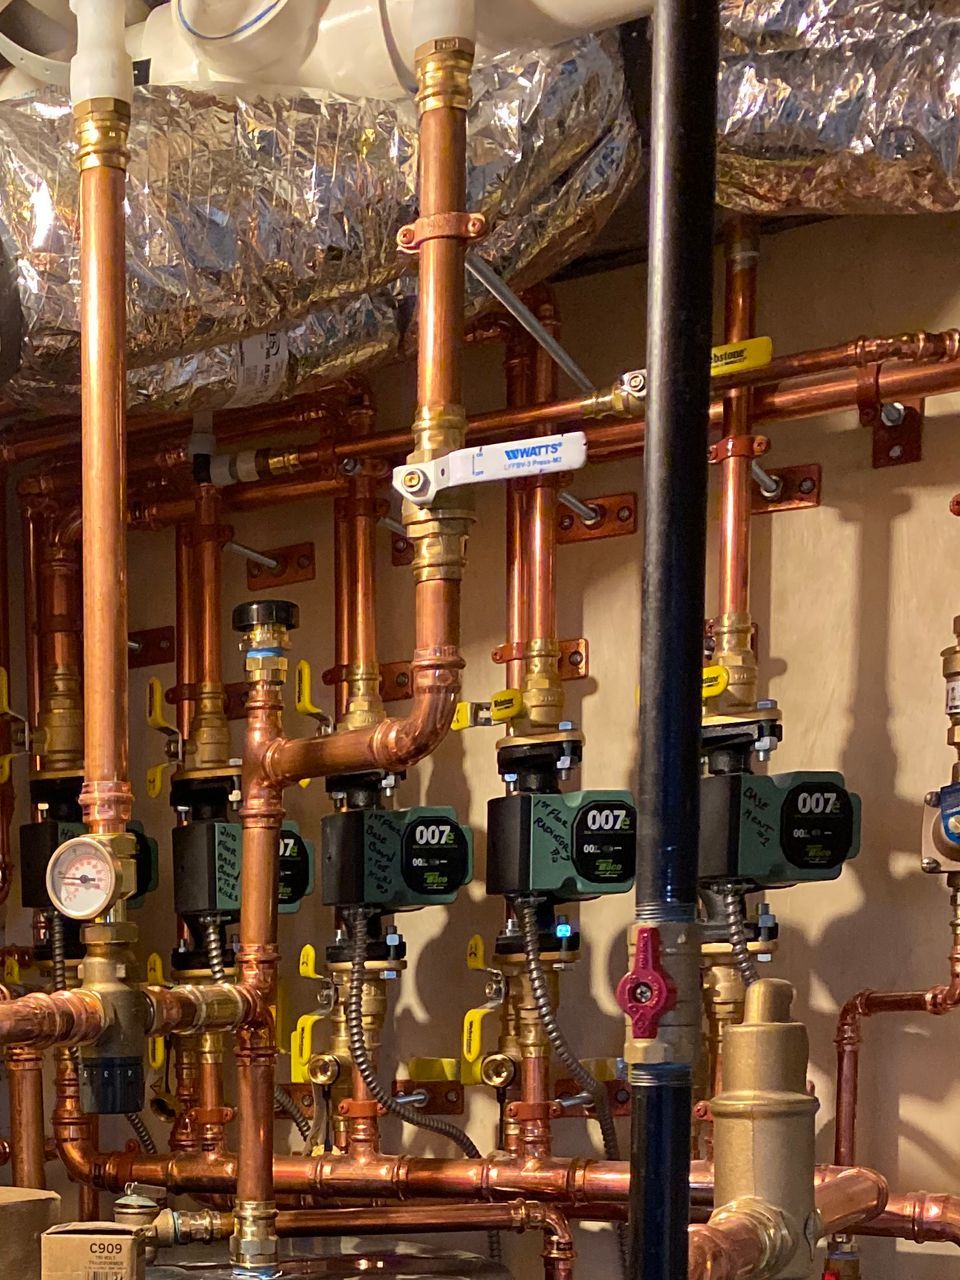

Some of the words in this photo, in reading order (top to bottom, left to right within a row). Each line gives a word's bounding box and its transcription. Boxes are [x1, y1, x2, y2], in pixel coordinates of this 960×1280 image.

[586, 809, 632, 830] 007e
[415, 825, 456, 845] 007e
[89, 1242, 123, 1254] C909
